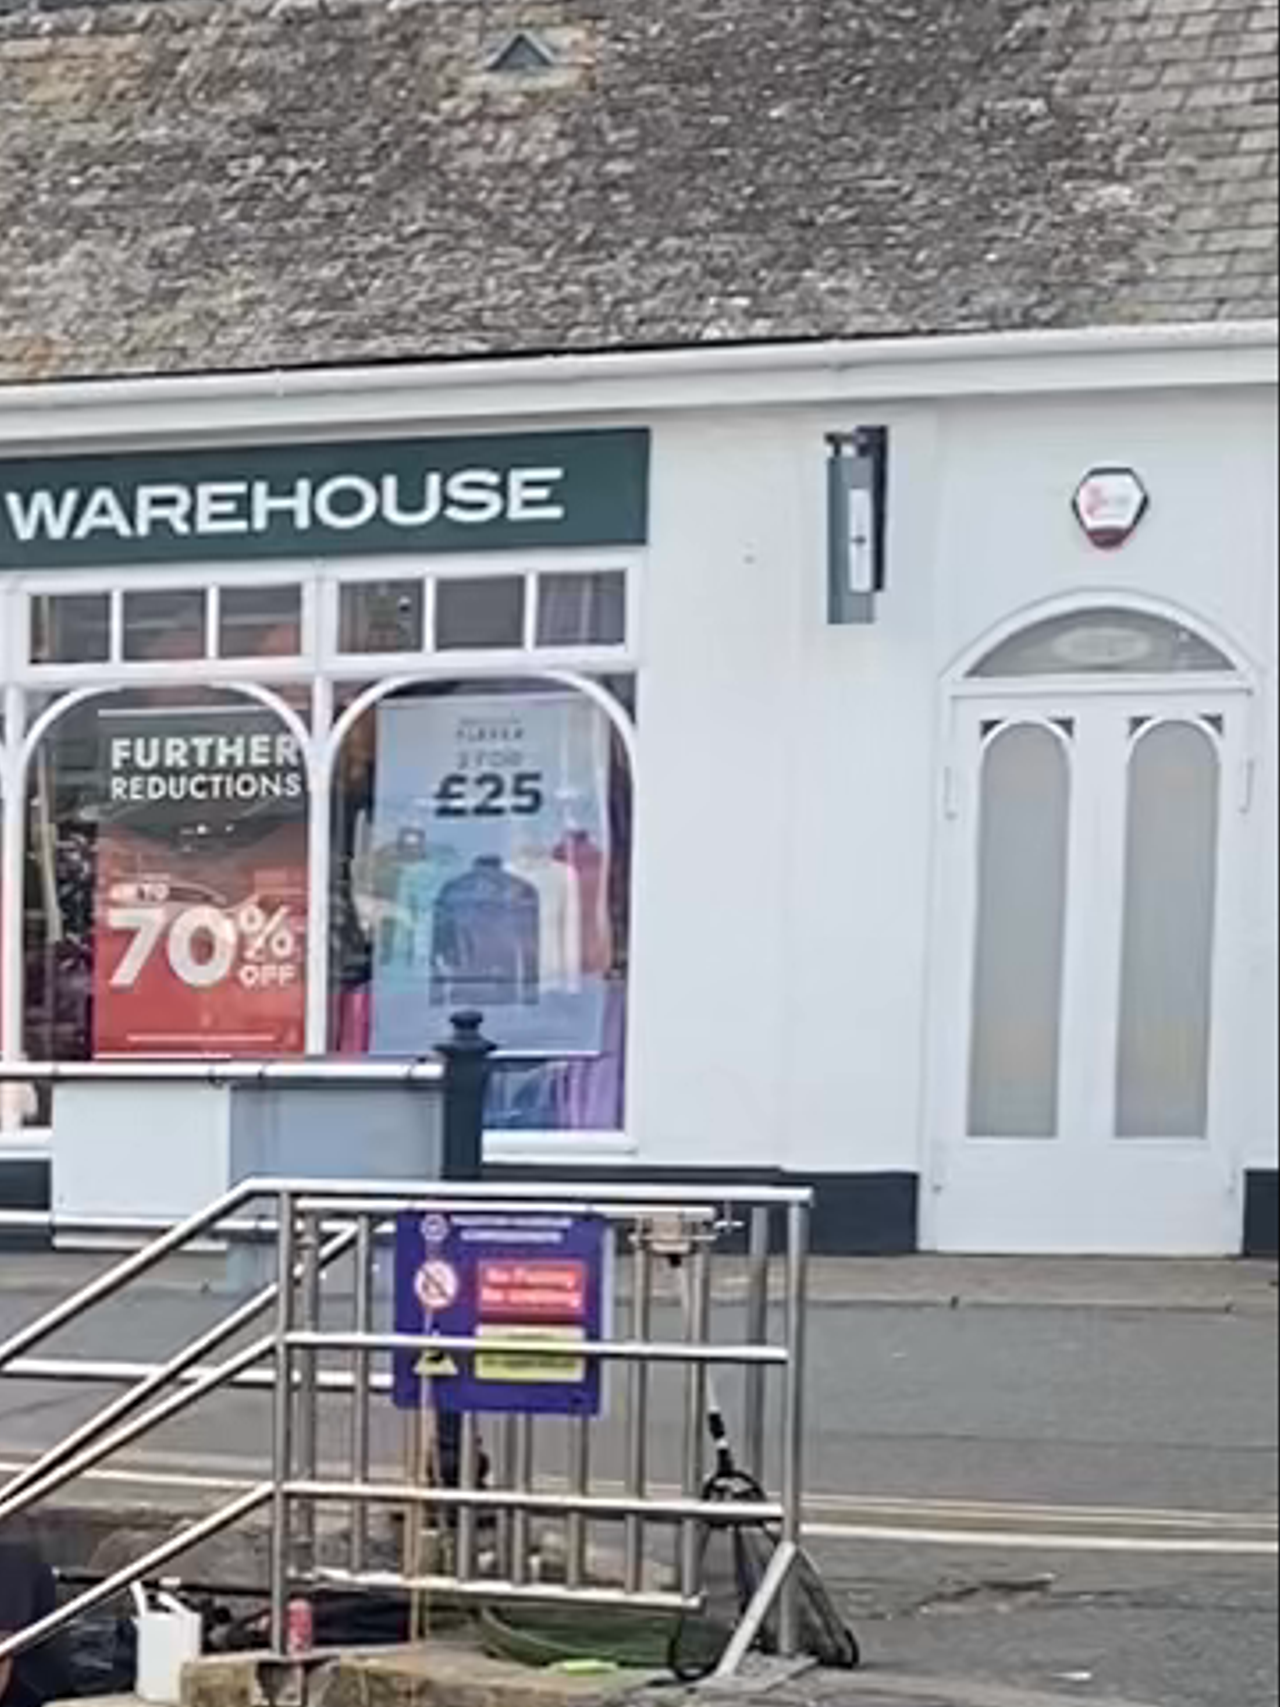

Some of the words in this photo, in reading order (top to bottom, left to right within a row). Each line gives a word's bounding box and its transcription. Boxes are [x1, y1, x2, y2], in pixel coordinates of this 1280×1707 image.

[3, 467, 564, 540] WAREHOUSE
[111, 734, 300, 770] FURTHER
[111, 773, 303, 800] REDUCTIONS
[433, 772, 544, 818] £25
[108, 904, 296, 987] 70%
[239, 963, 295, 986] OFF
